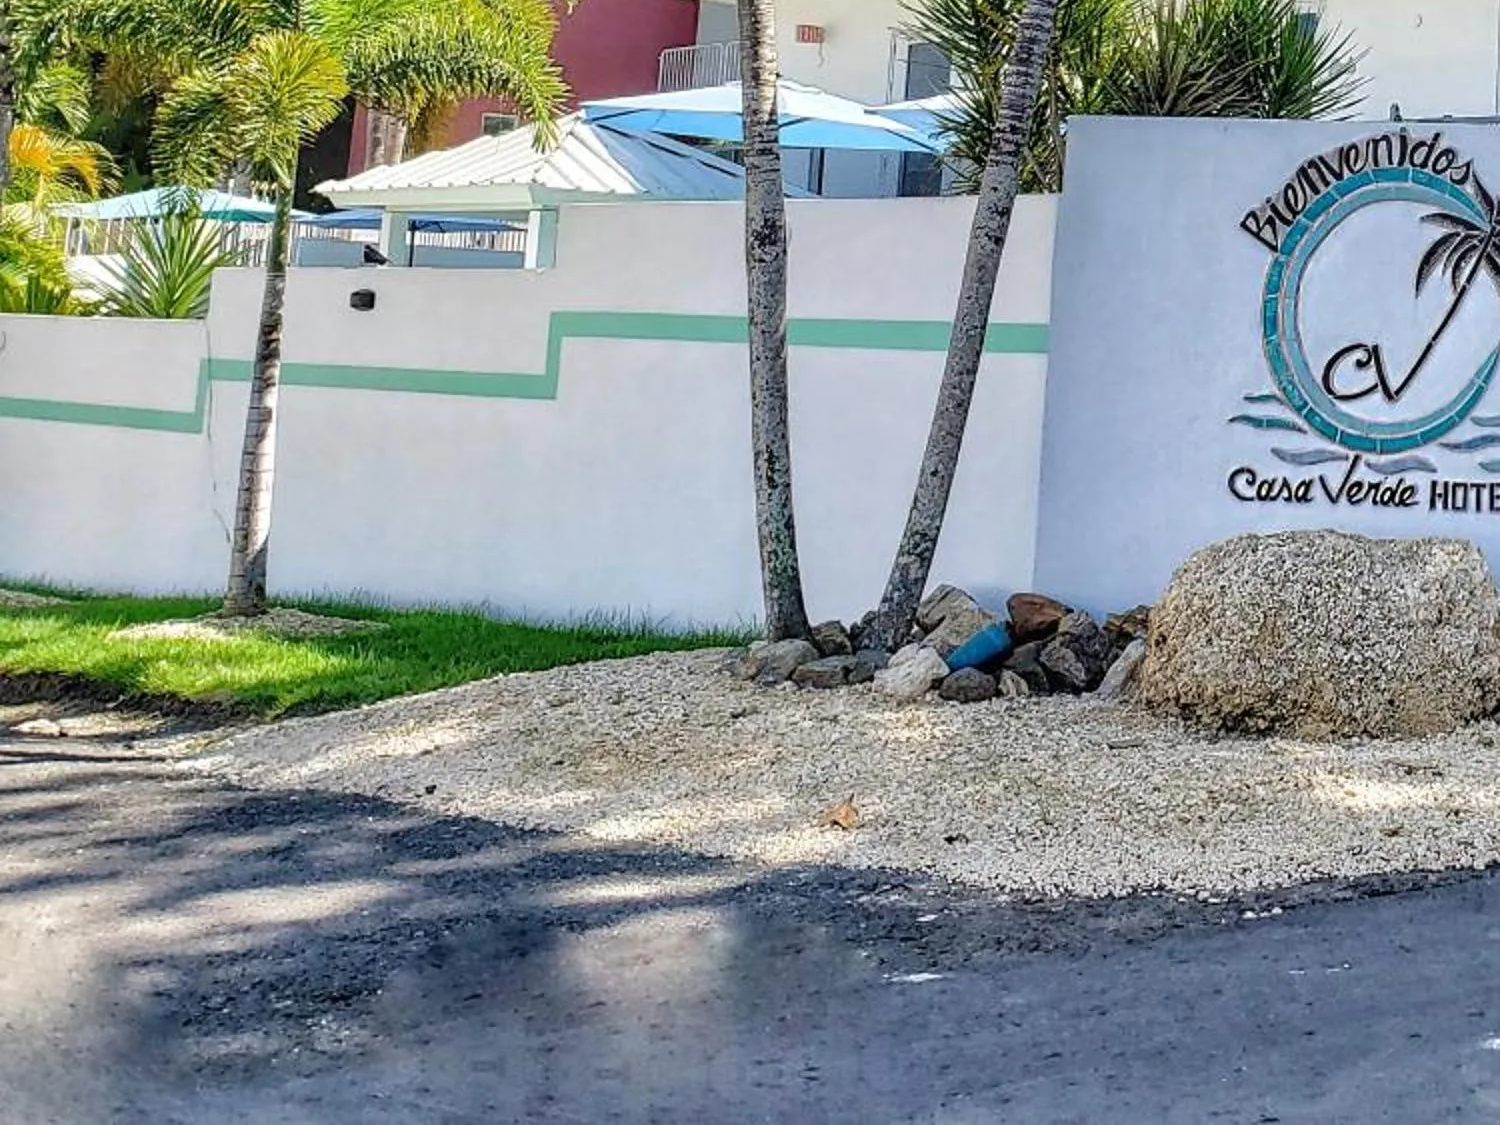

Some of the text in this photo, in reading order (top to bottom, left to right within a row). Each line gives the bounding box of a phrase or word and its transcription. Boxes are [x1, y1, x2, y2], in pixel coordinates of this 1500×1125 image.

[1239, 127, 1474, 253] Bienvenidos
[1227, 466, 1313, 504] Casa
[1319, 454, 1420, 508] Verde
